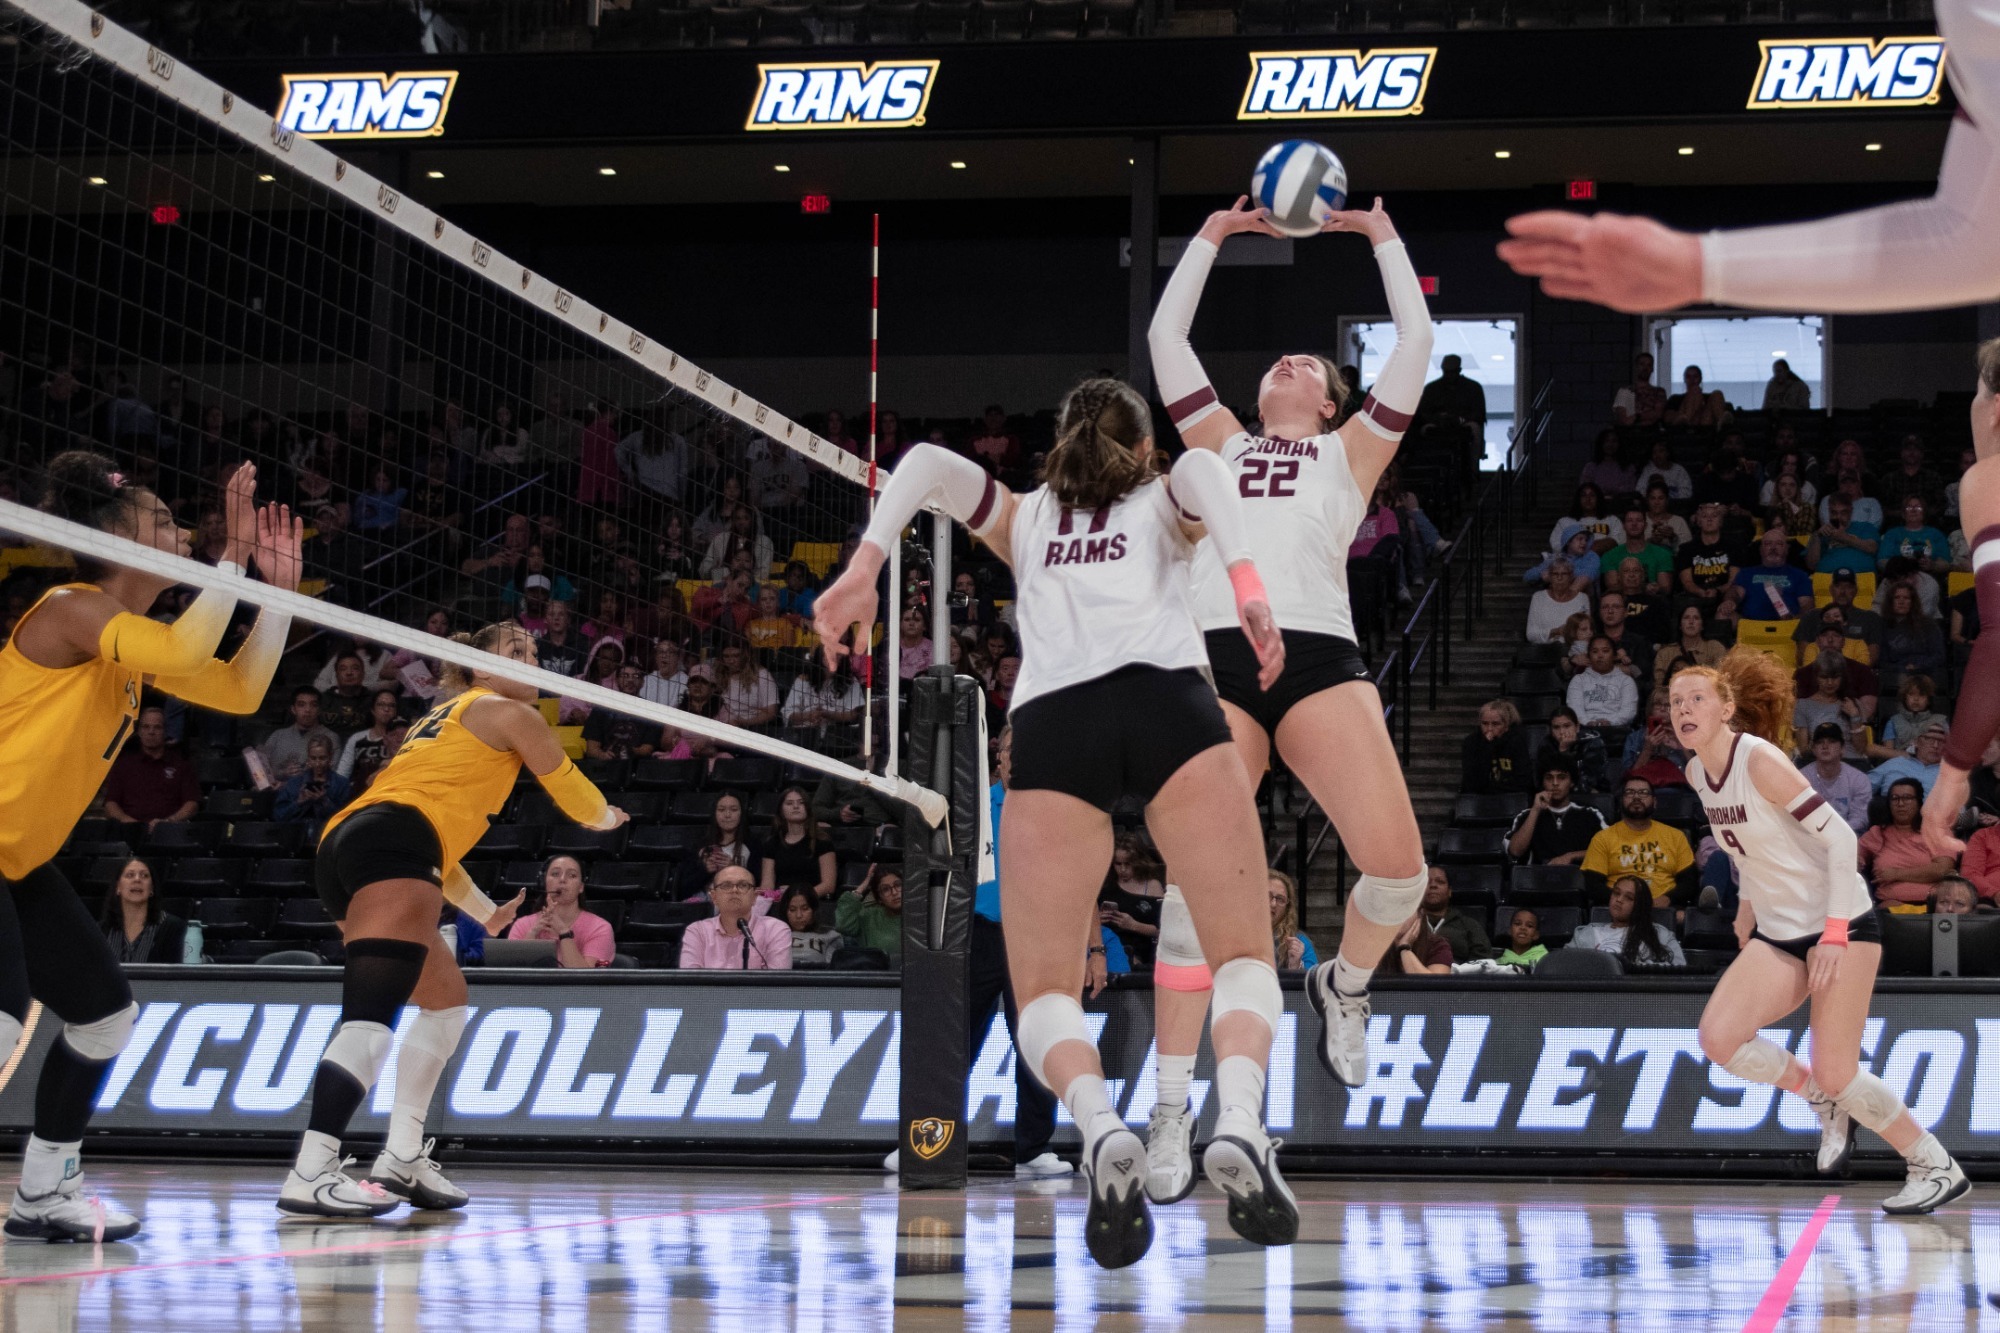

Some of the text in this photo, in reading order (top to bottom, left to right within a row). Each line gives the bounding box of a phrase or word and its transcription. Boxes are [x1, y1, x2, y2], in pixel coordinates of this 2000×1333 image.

[1249, 56, 1426, 111] RAMS
[1758, 44, 1941, 100] RAMS
[281, 79, 448, 132] RAMS
[757, 68, 929, 123] RAMS
[806, 195, 828, 213] EXIT
[1571, 181, 1593, 199] EXIT
[1239, 458, 1300, 498] 22
[1045, 532, 1128, 568] RAMS
[1621, 841, 1661, 854] RUN
[1721, 829, 1746, 856] 9
[792, 937, 825, 955] CU
